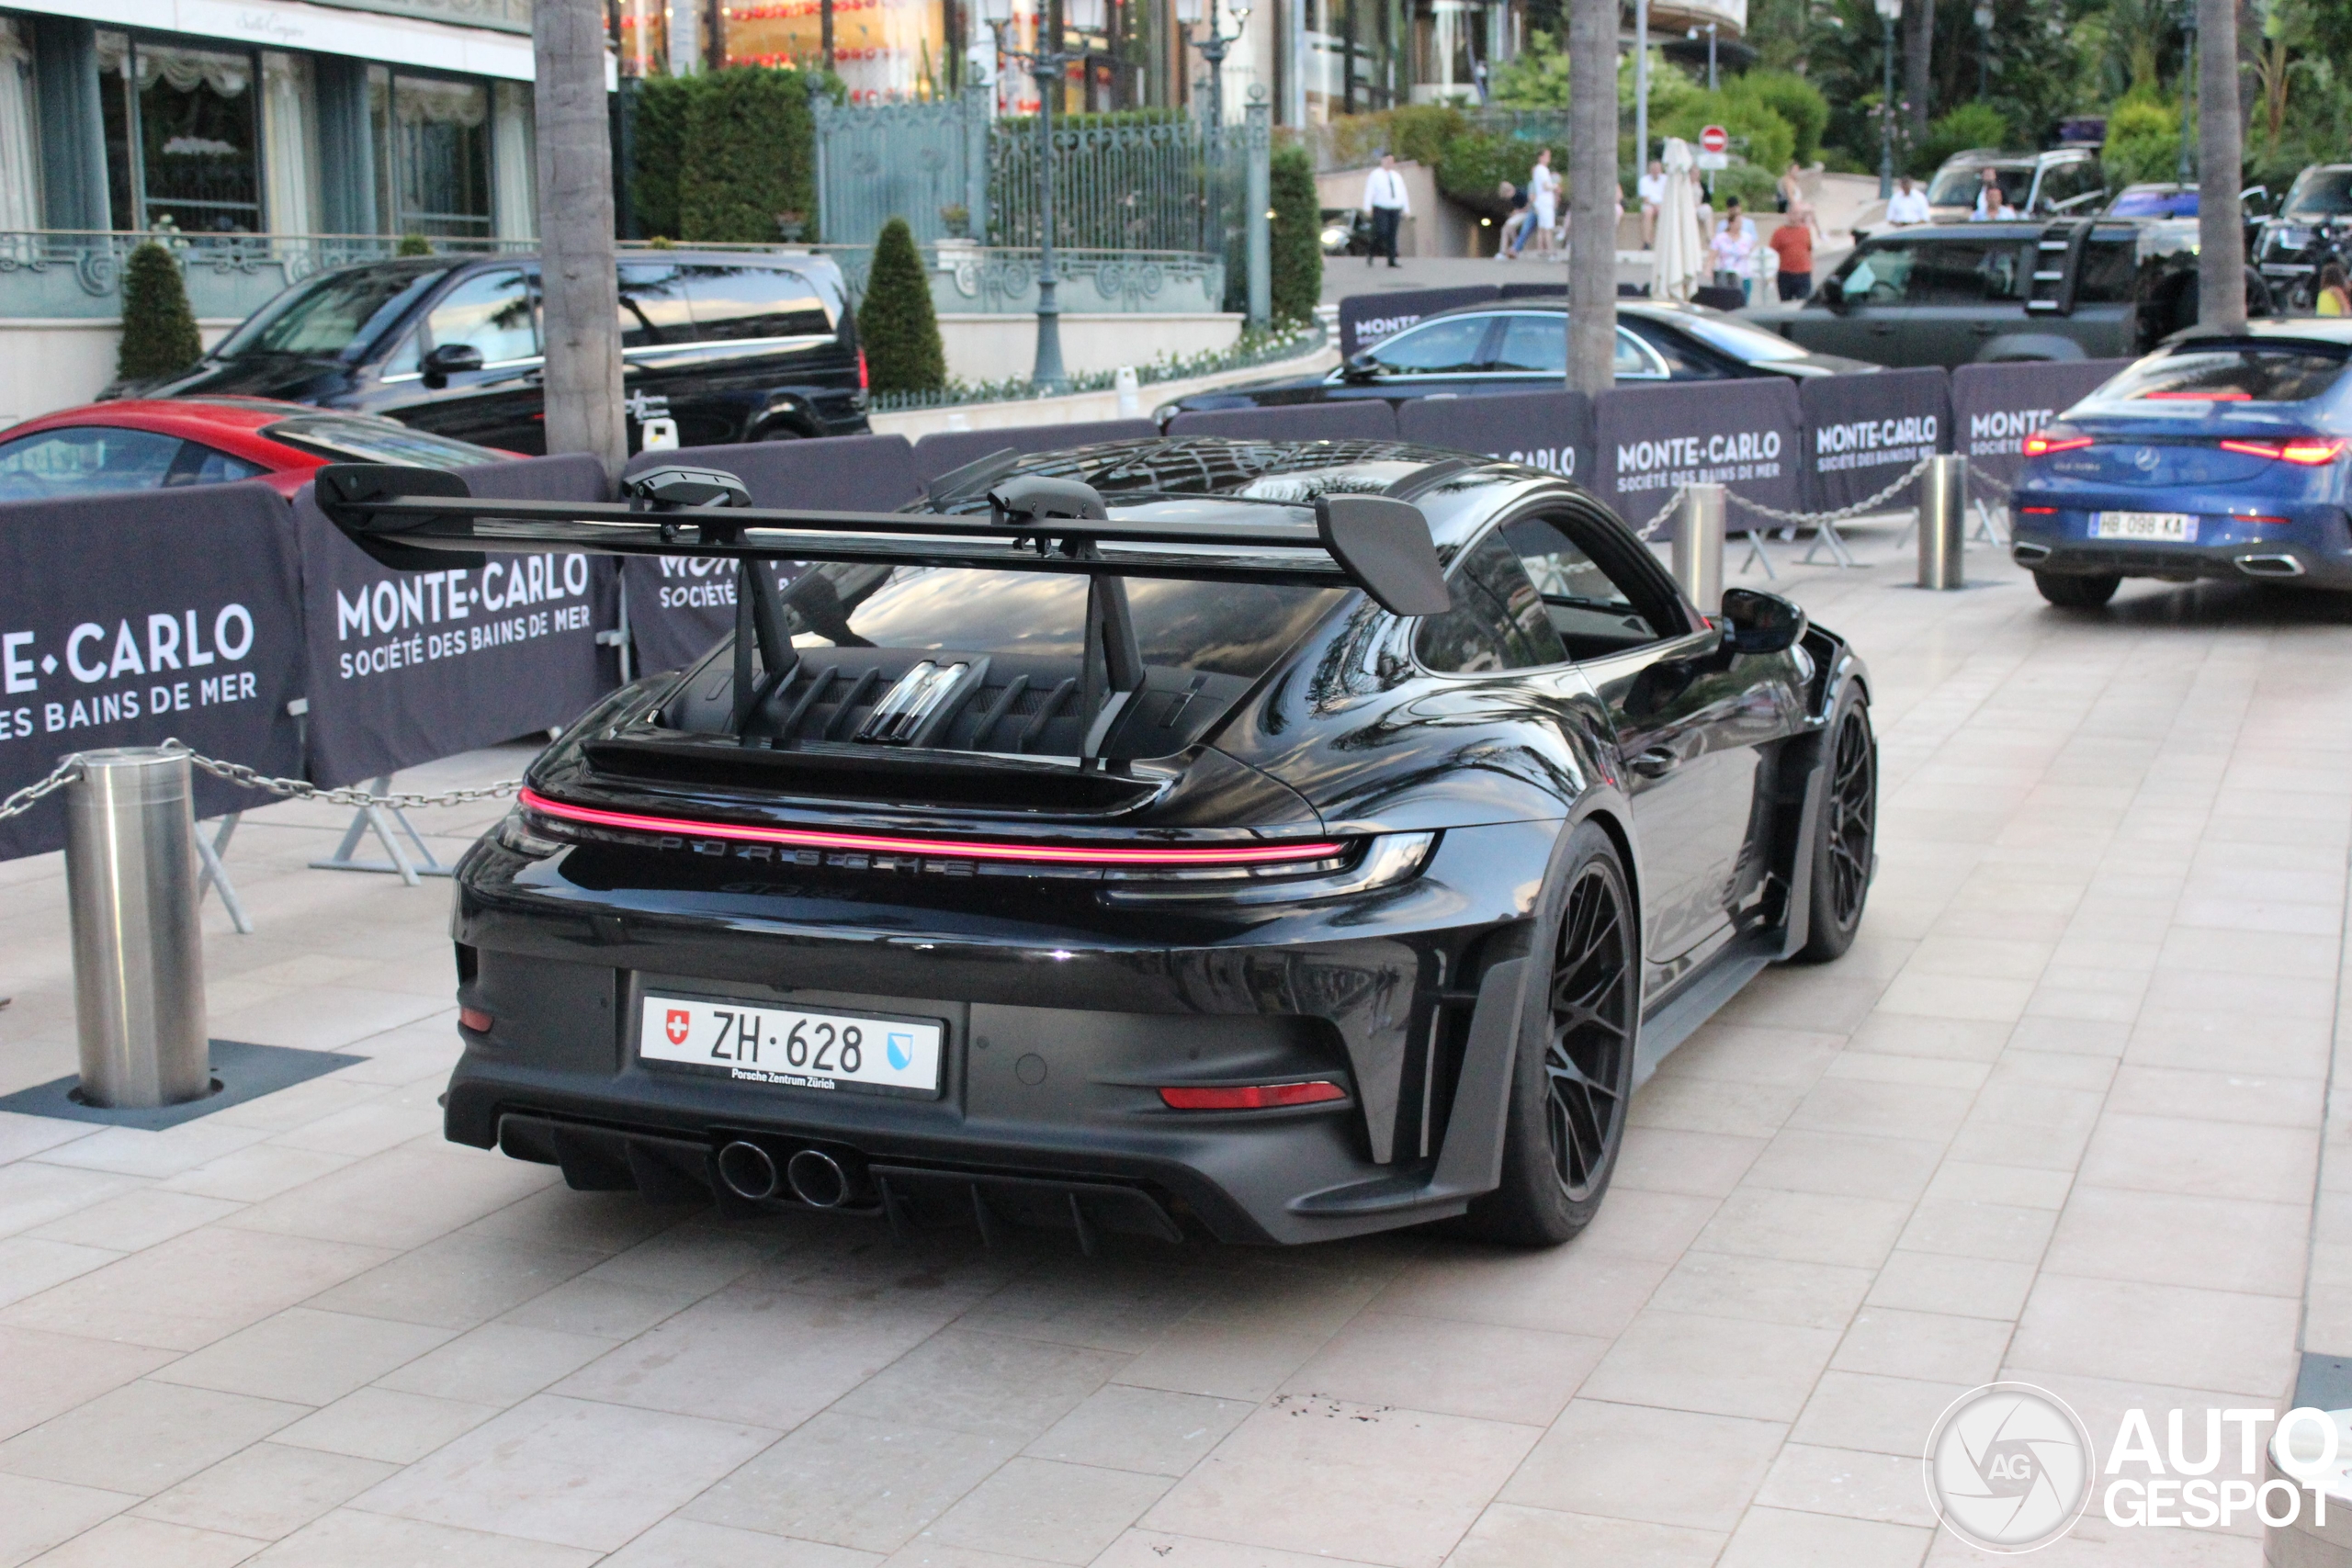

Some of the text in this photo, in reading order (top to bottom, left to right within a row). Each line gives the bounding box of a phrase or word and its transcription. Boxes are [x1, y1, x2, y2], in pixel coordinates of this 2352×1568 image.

[659, 579, 738, 608] SOCIÉTÉ
[340, 605, 590, 679] SOCIÉTÉ DES BAINS DE MER
[45, 691, 140, 732] BAINS
[151, 682, 191, 715] DE
[201, 671, 257, 706] MER
[661, 836, 975, 877] PORSCHE
[731, 1068, 835, 1090] Porsche Zentrum Zürich
